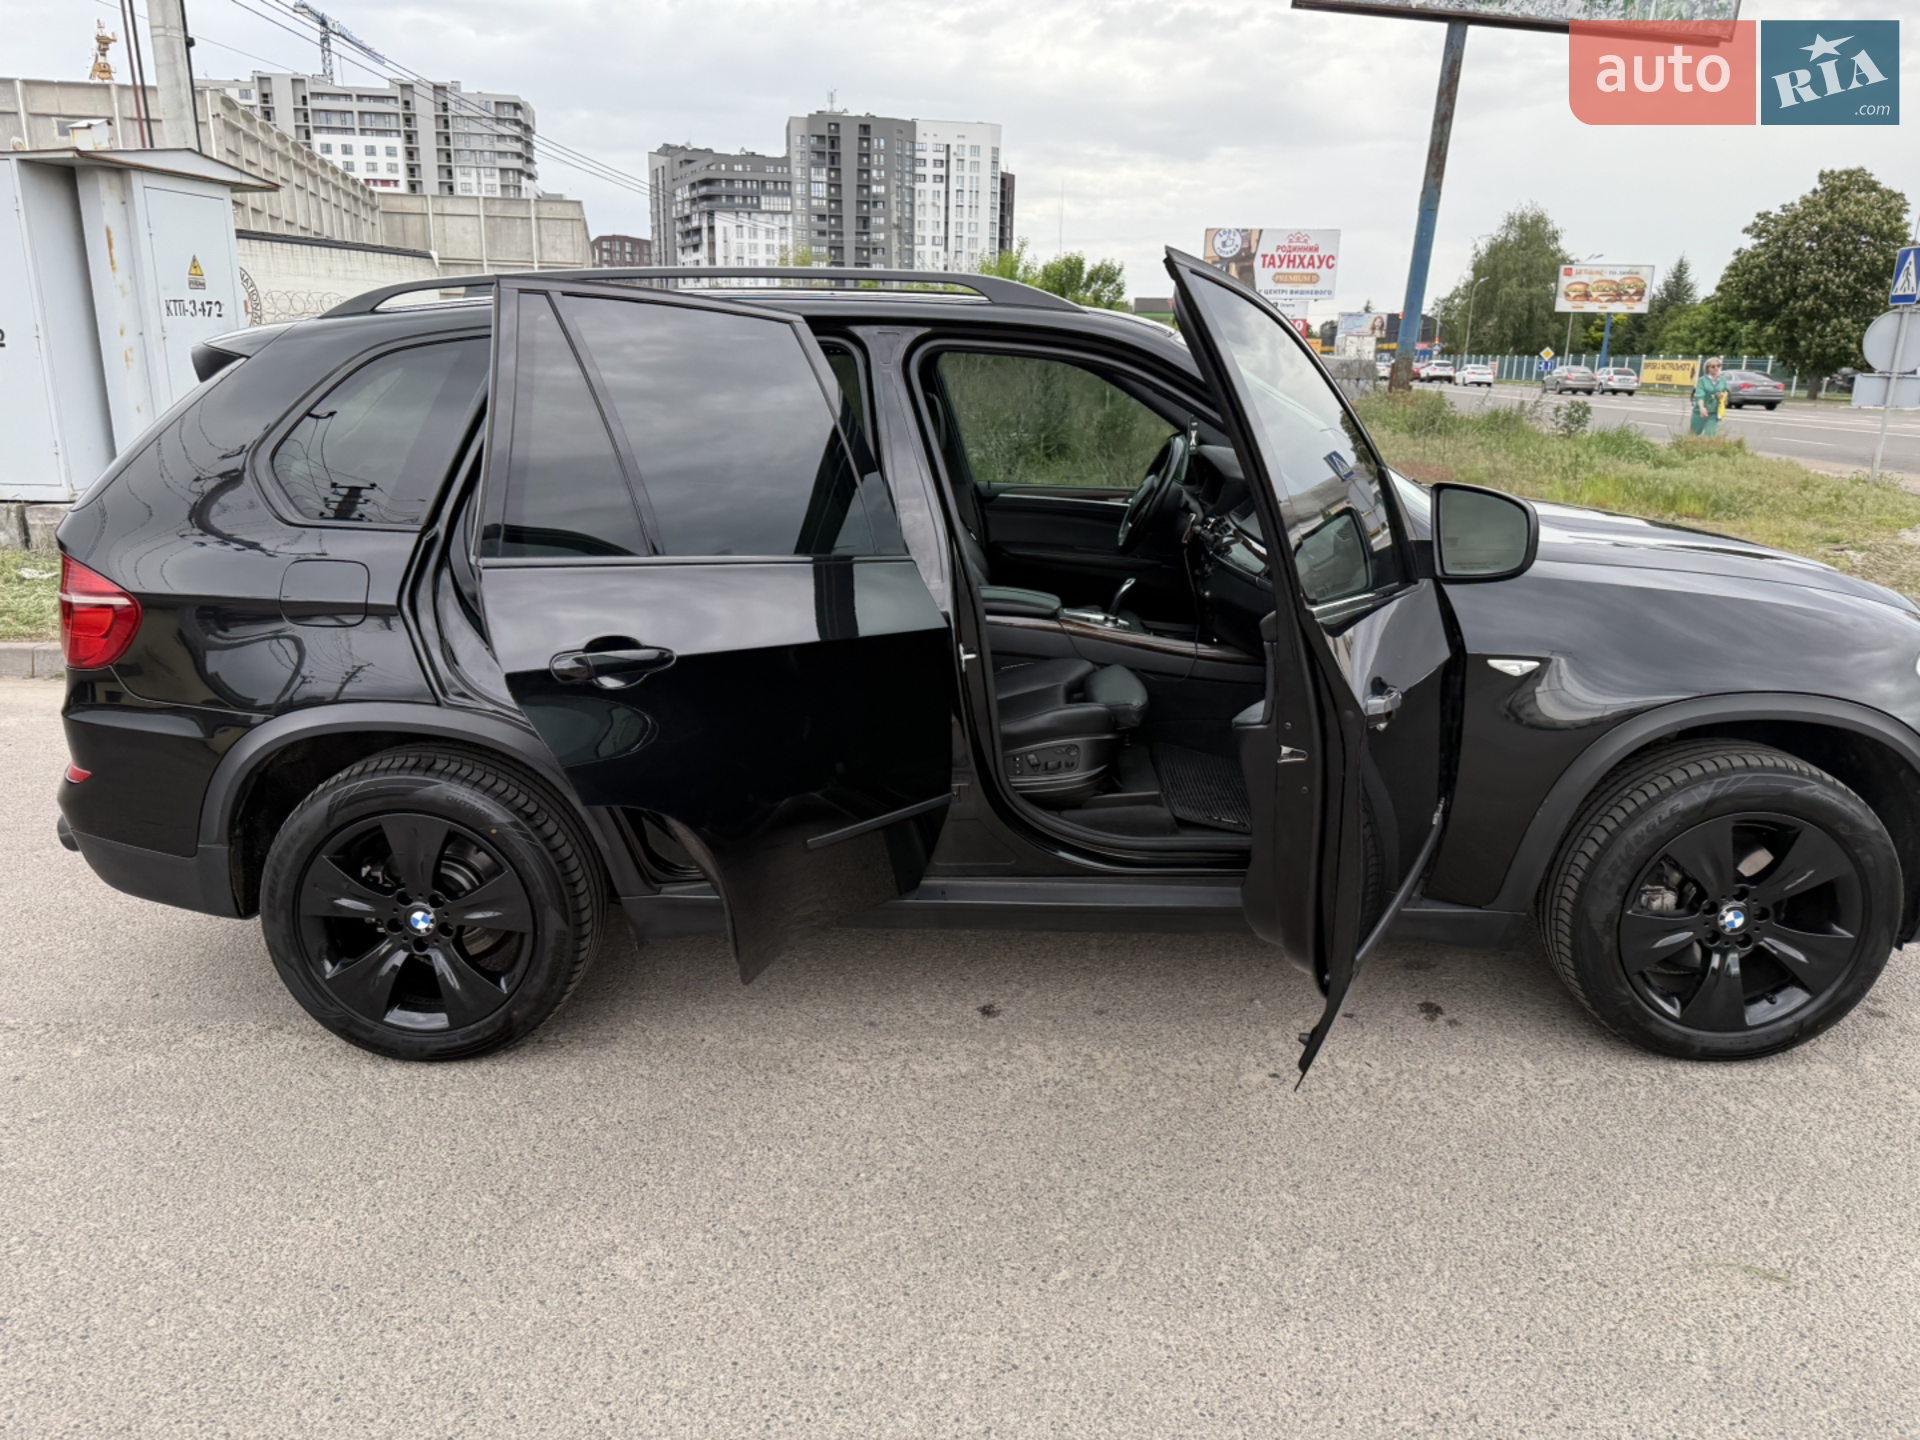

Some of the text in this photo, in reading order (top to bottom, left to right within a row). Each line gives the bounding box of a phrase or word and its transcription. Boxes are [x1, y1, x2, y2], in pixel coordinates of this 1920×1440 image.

[1276, 243, 1320, 254] РОДИННИЙ
[1261, 253, 1337, 270] ТАУНХАУС
[1275, 274, 1310, 282] PREMIUM
[1263, 288, 1289, 296] ЦЕНТРІ
[1289, 288, 1333, 296] ВИШНЕВОГО
